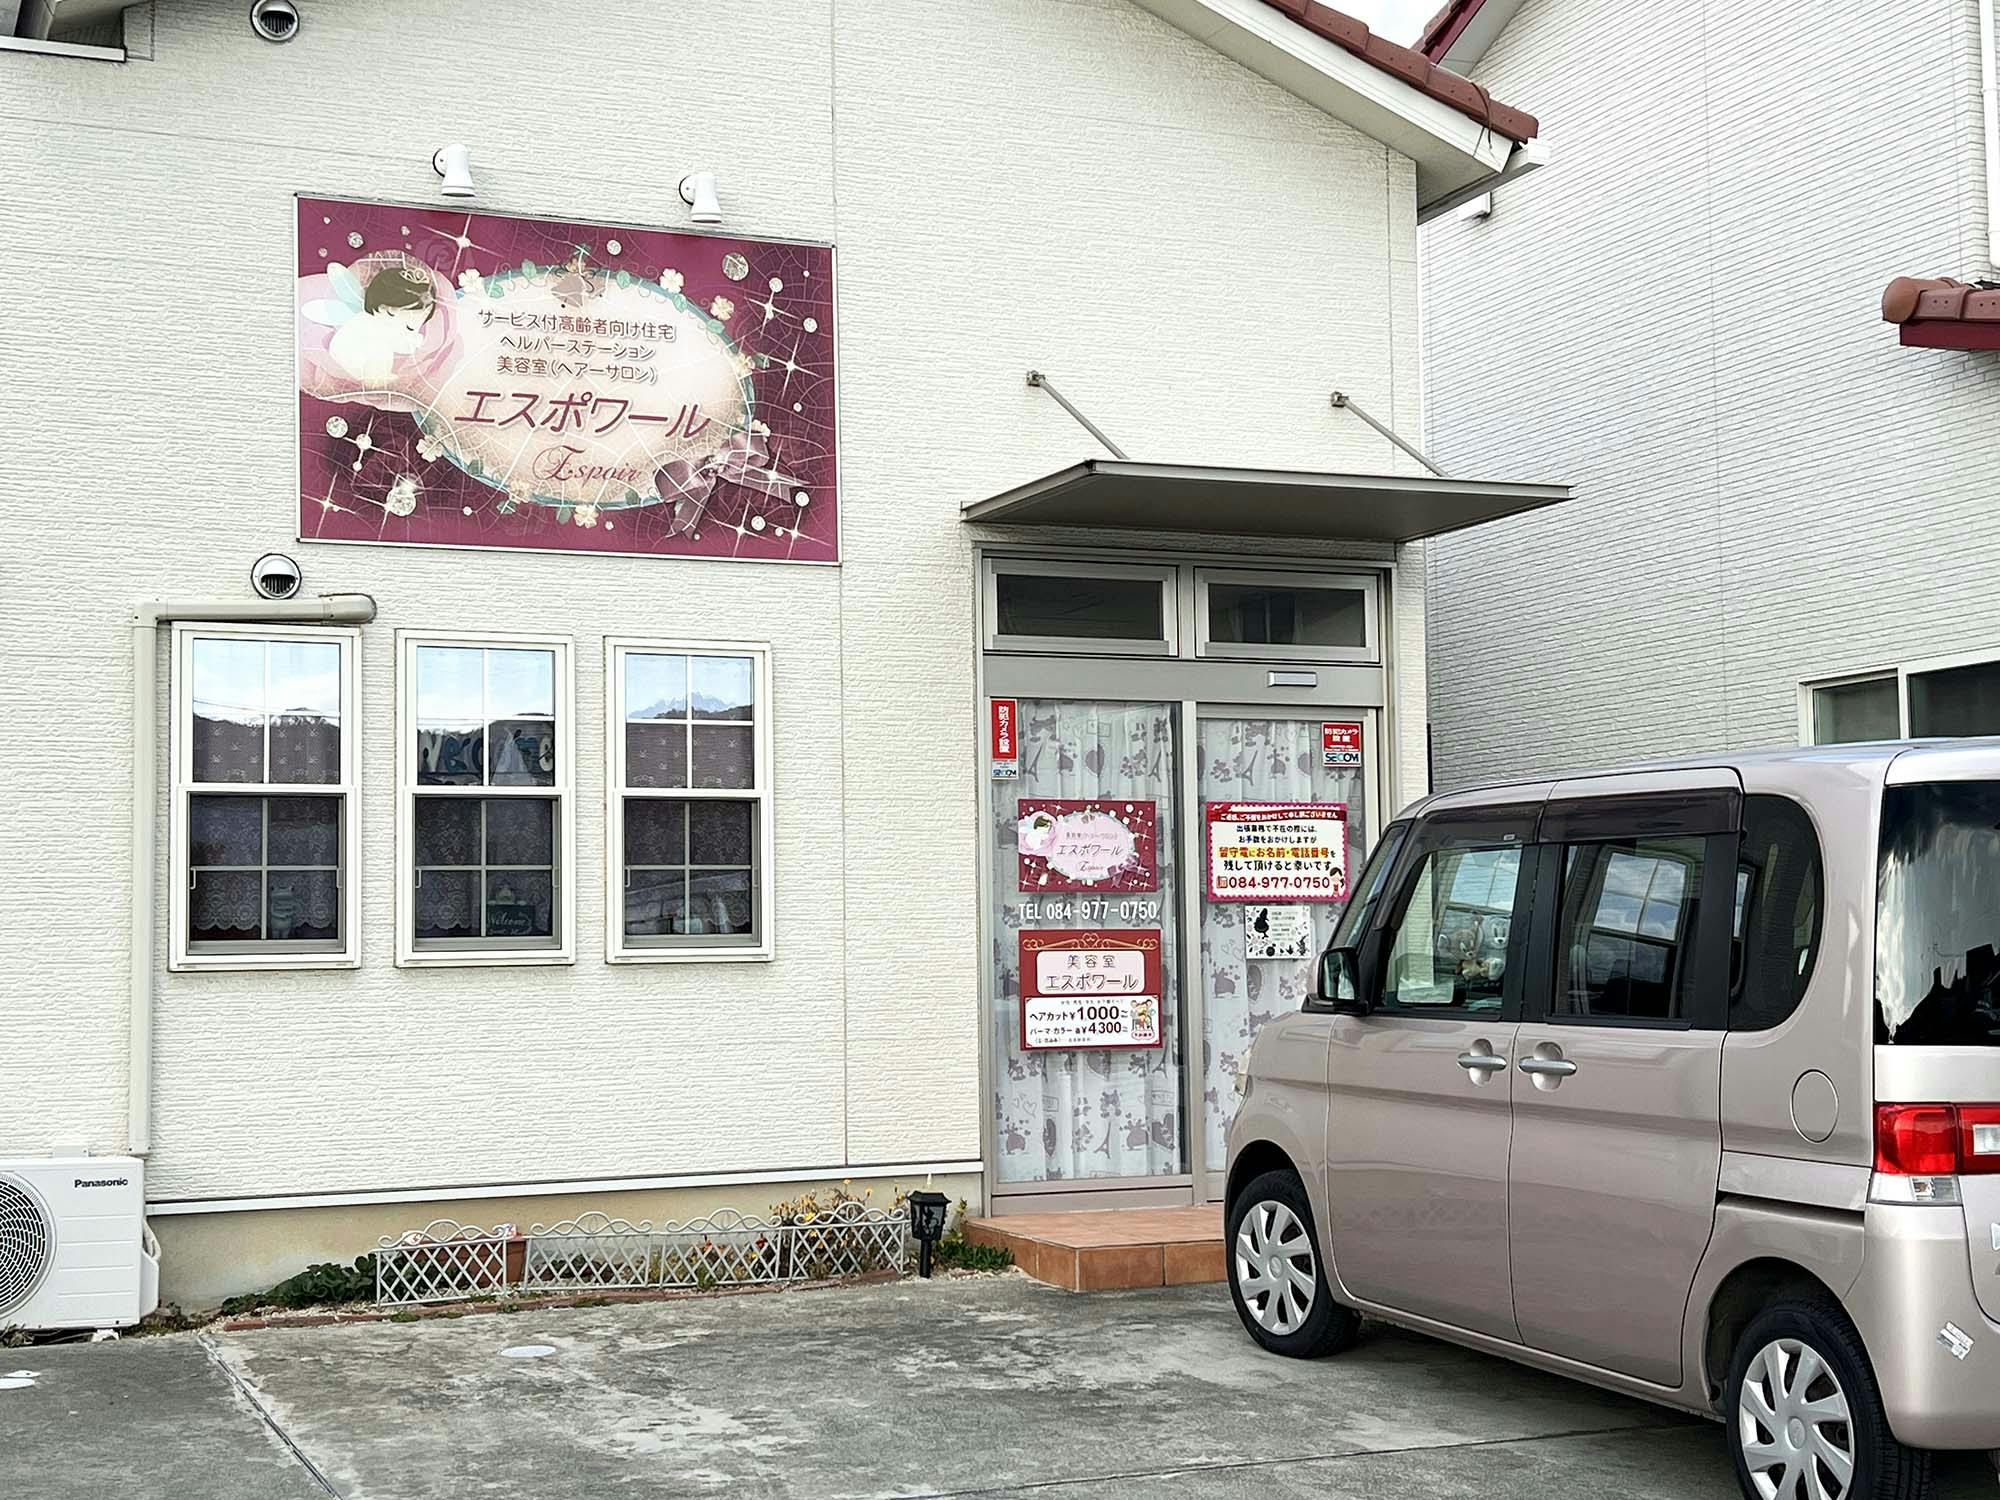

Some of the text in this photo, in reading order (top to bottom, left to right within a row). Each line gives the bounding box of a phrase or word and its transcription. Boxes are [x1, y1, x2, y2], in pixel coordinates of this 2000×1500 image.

[478, 309, 676, 341] サービス付高齢者向け住宅
[500, 334, 655, 361] ヘルパーステーション
[497, 356, 657, 383] 美容室(ヘアーサロン)
[454, 391, 712, 438] エスポワール
[532, 445, 642, 488] Espoir
[1325, 752, 1359, 762] SECOM
[1056, 843, 1122, 857] エスポワール
[1223, 860, 1332, 871] 残して頂けると幸いです
[1229, 877, 1331, 888] 084-977-0750
[1019, 901, 1157, 920] TEL 084-977-0750
[1067, 954, 1116, 969] 美容室
[1045, 972, 1139, 991] エスポワール
[1029, 1011, 1068, 1022] ヘアカット
[74, 1177, 128, 1188] Panasonic
